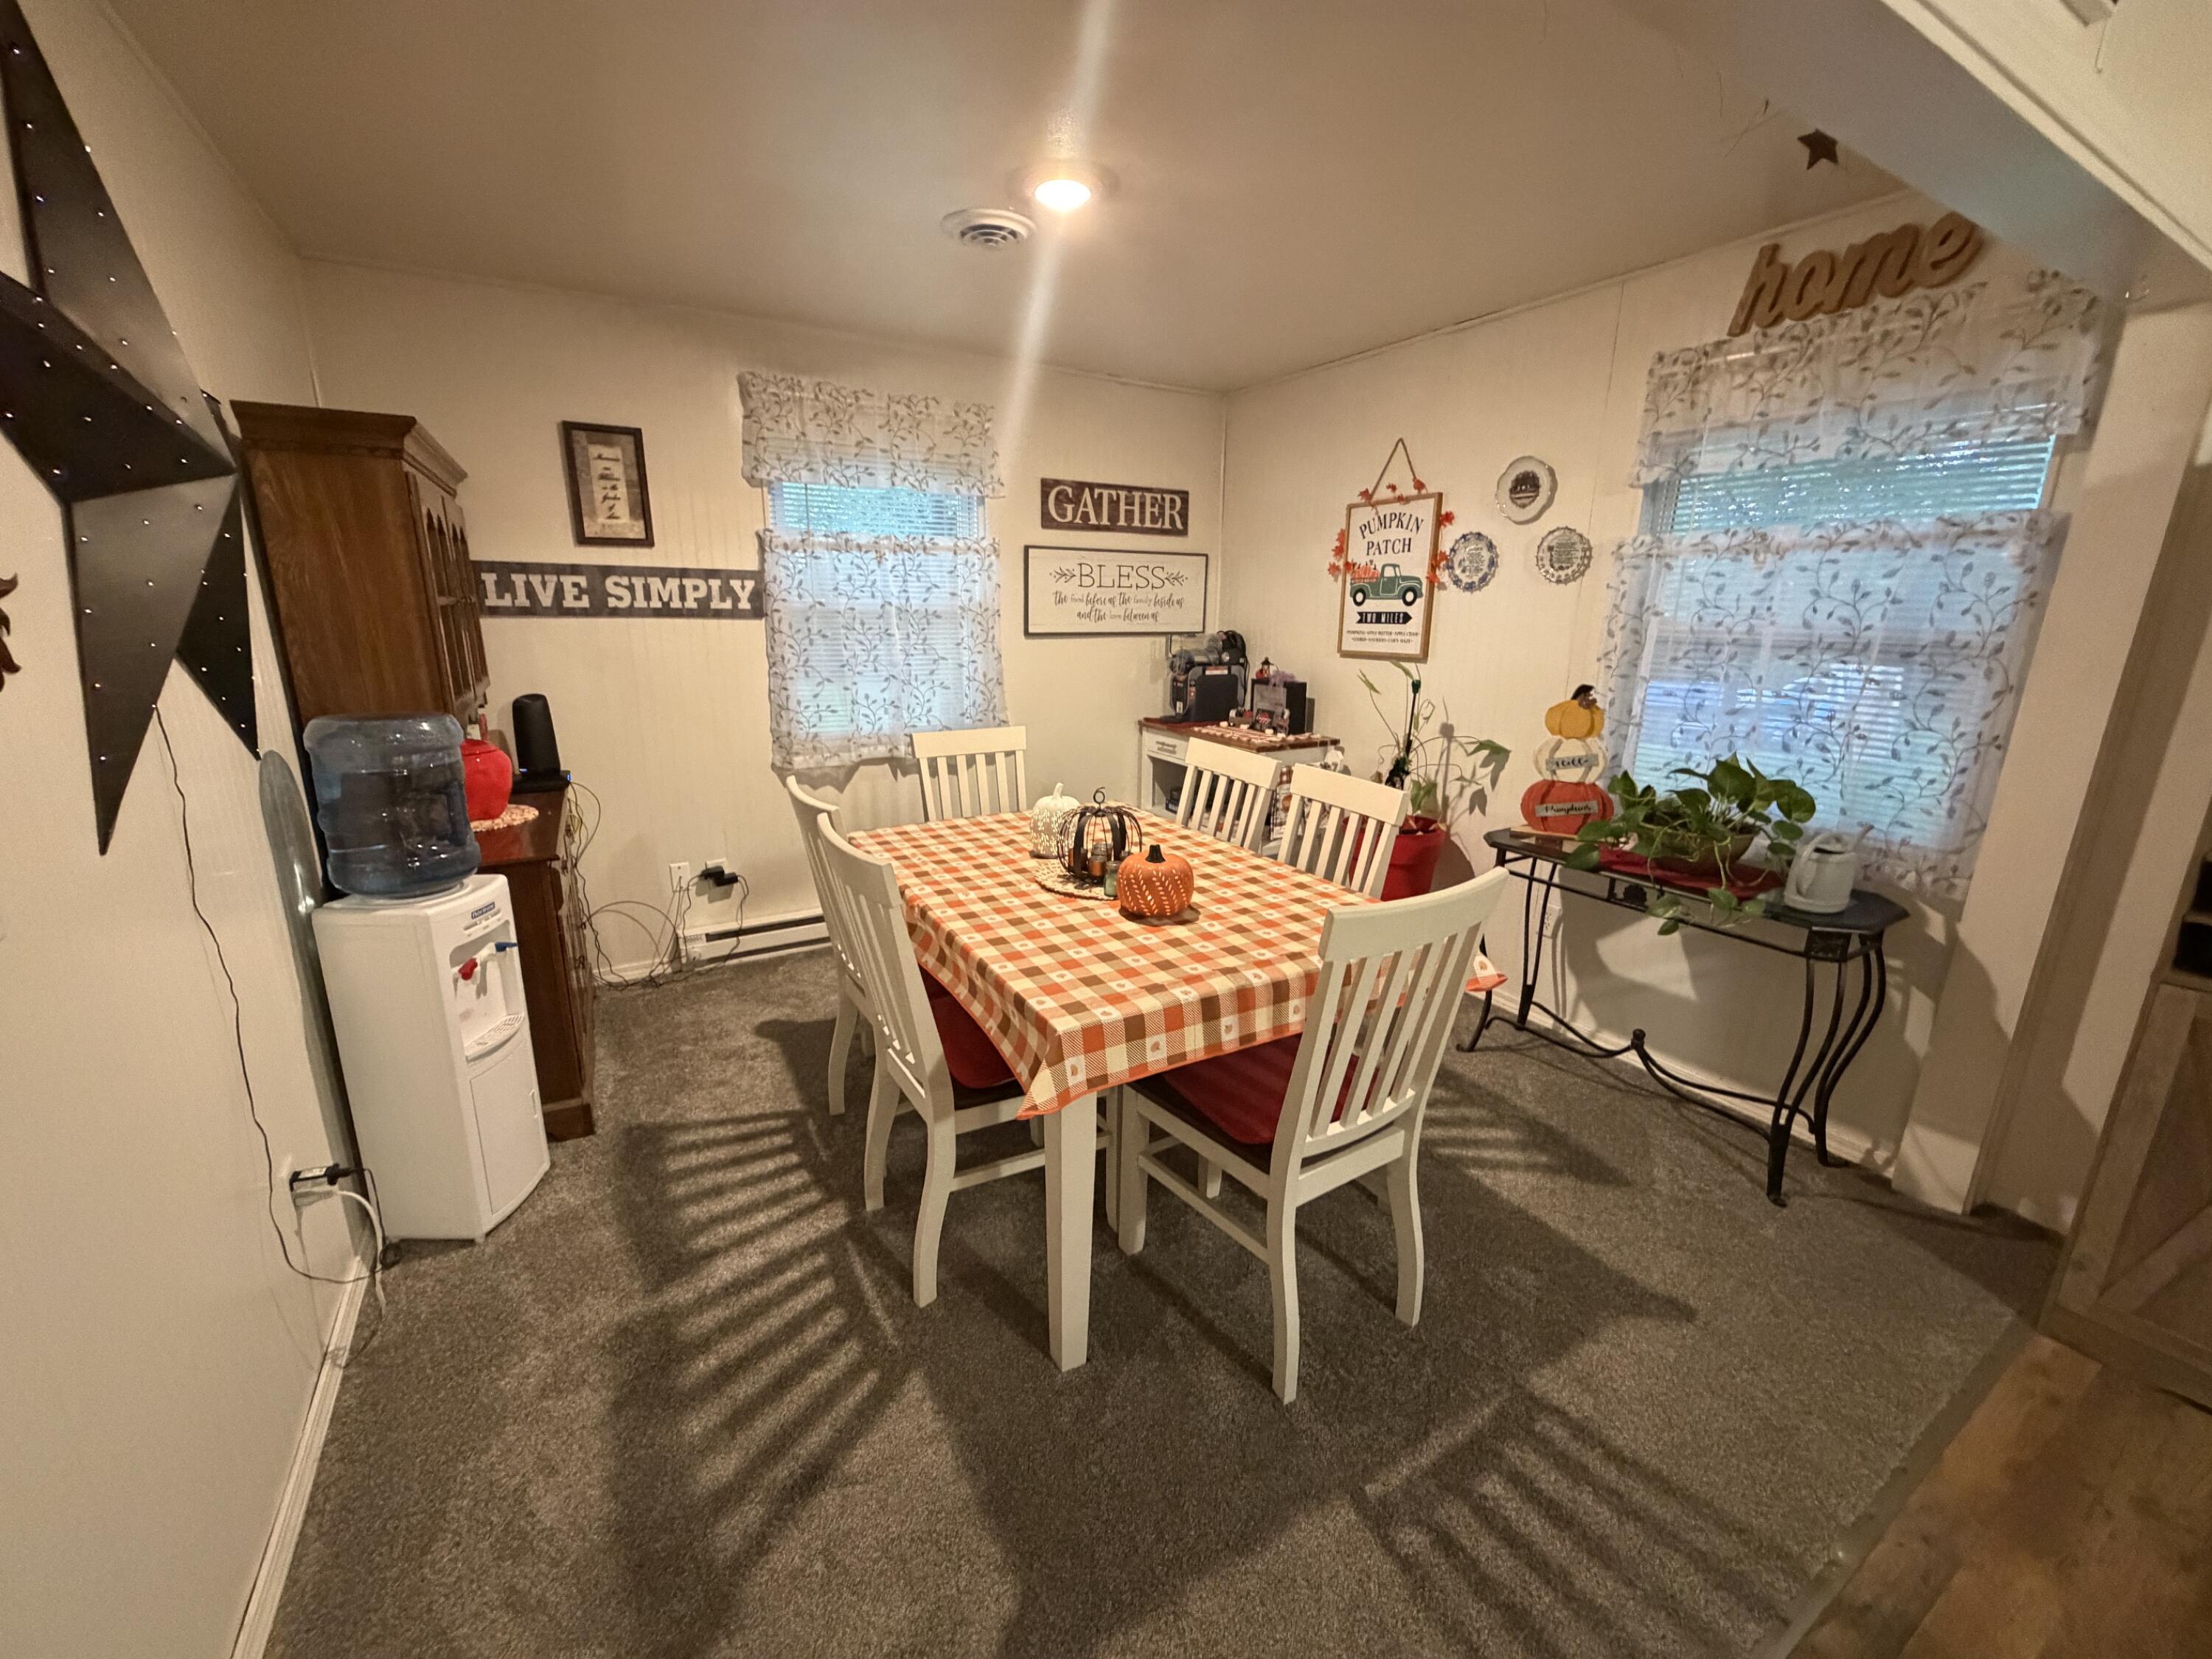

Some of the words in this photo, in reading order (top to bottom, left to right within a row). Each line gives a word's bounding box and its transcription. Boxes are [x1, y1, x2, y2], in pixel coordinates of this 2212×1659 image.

[1727, 211, 1983, 338] home
[1048, 485, 1184, 530] GATHER
[1359, 512, 1424, 540] PUMPKIN
[1366, 538, 1411, 556] PATCH
[1077, 563, 1165, 590] BLESS
[481, 572, 589, 608] LIVE
[605, 575, 755, 610] SIMPLY
[1085, 592, 1107, 607] before
[1077, 606, 1092, 622] and
[1123, 608, 1150, 622] between
[1363, 613, 1377, 623] TWO
[1381, 613, 1404, 624] MILES
